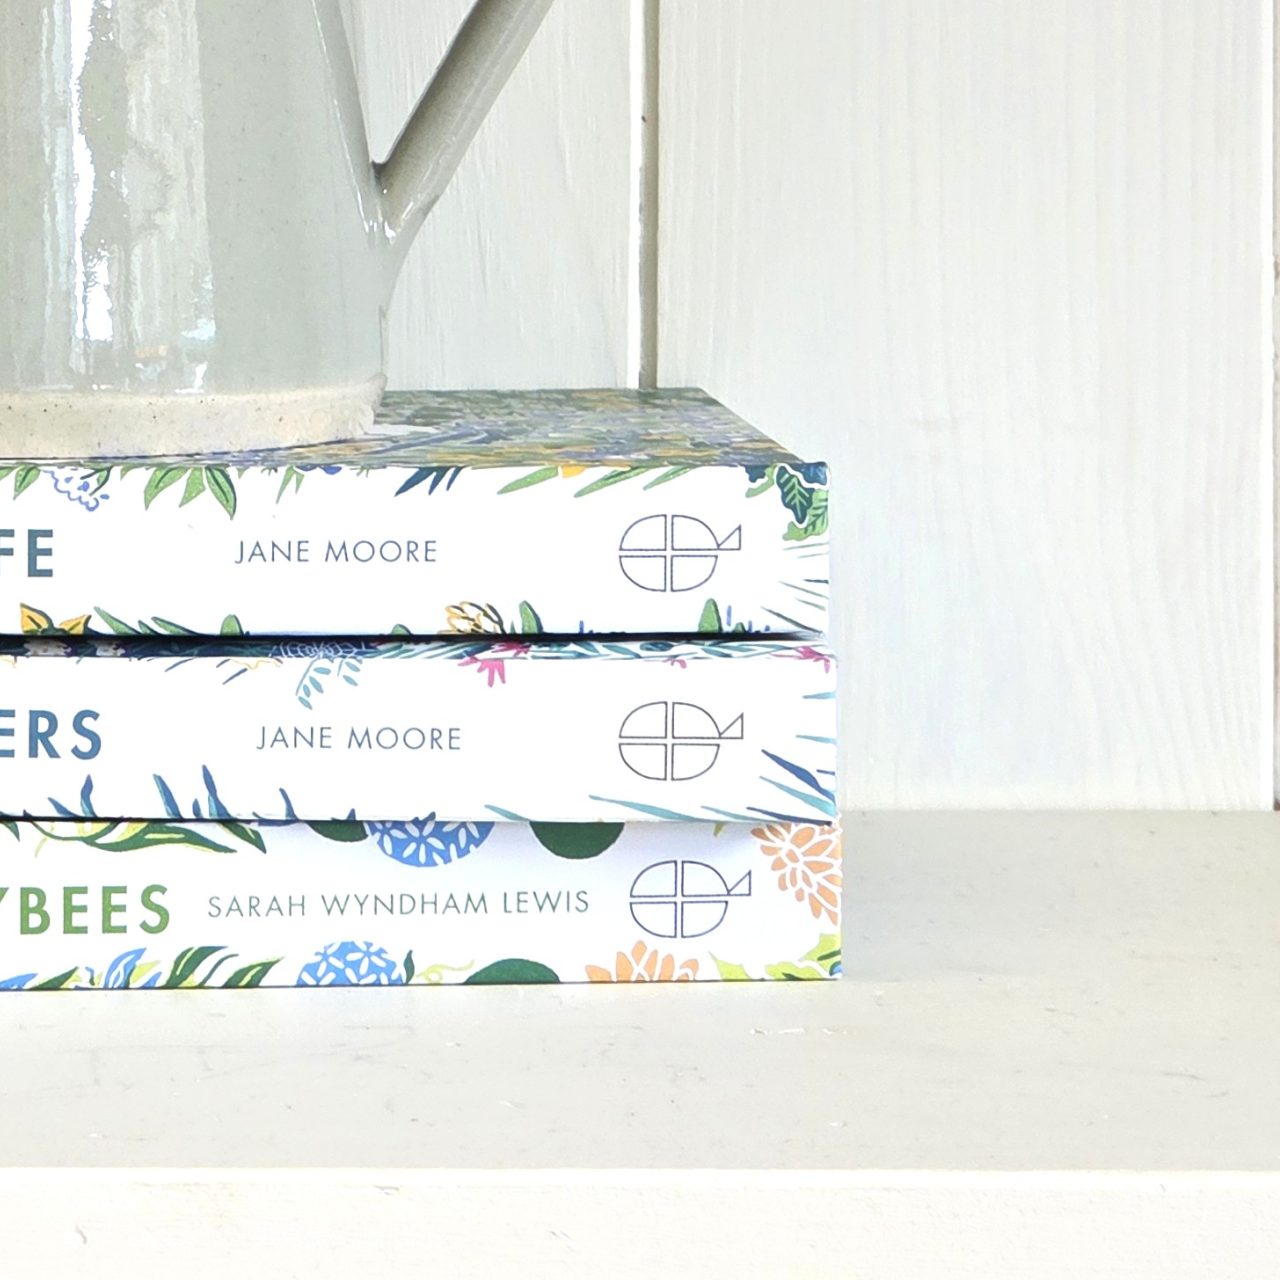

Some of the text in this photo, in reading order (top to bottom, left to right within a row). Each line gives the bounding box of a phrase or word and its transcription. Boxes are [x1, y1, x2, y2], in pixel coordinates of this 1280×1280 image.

[234, 540, 437, 565] JANE MOORE
[256, 725, 461, 750] JANE MOORE
[208, 890, 589, 918] SARAH WYNDHAM LEWIS
